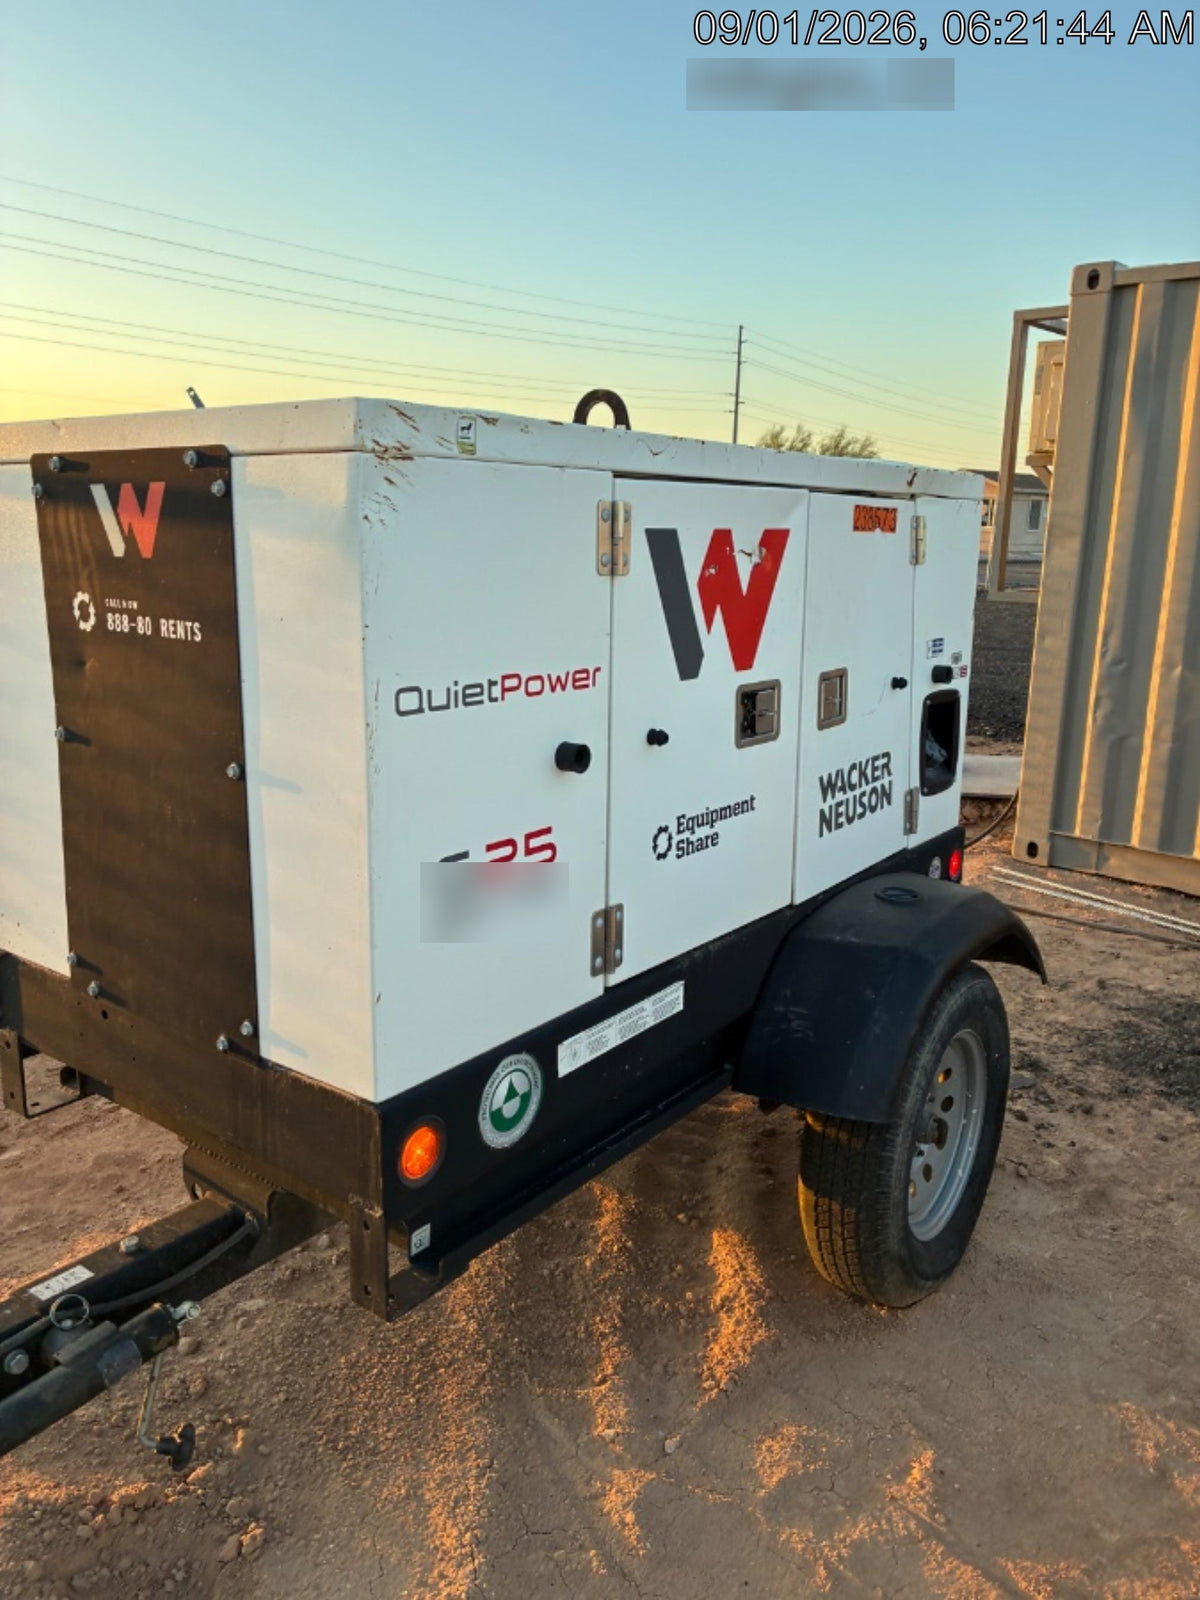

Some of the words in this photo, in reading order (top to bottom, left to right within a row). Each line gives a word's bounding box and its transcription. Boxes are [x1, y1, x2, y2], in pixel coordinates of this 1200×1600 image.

[107, 612, 152, 636] 888-80
[160, 618, 202, 642] RENTS
[395, 666, 602, 717] QuietPower
[818, 751, 893, 804] WACKER
[676, 794, 756, 836] Equipment
[819, 780, 893, 838] NEUSON
[675, 832, 720, 860] Share
